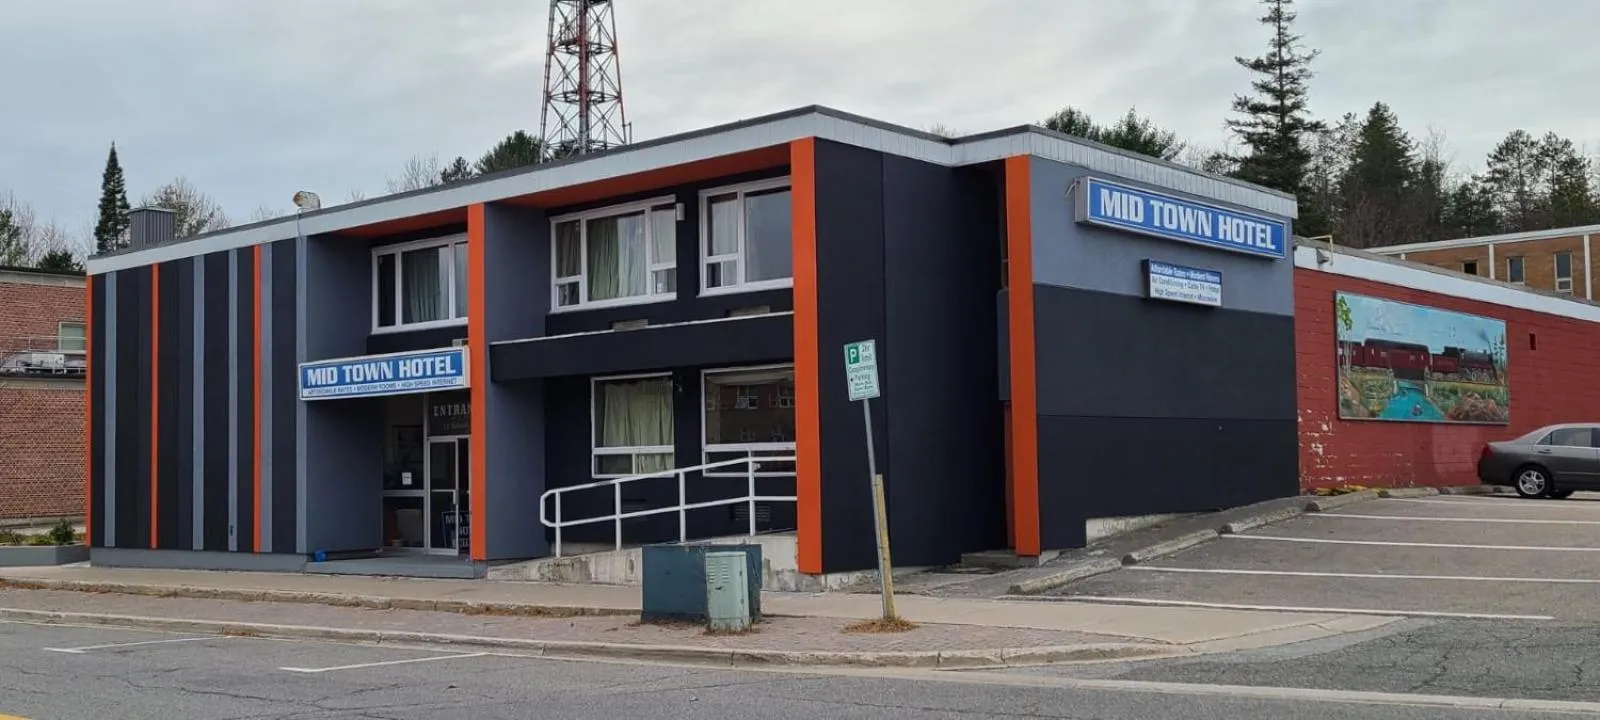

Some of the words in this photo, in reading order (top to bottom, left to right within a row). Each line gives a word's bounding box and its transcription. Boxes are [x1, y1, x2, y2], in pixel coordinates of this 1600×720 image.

[1100, 188, 1144, 223] MID
[1150, 200, 1212, 237] TOWN
[1218, 215, 1275, 250] HOTEL
[307, 367, 338, 386] MID
[342, 361, 393, 383] TOWN
[399, 355, 456, 379] HOTEL
